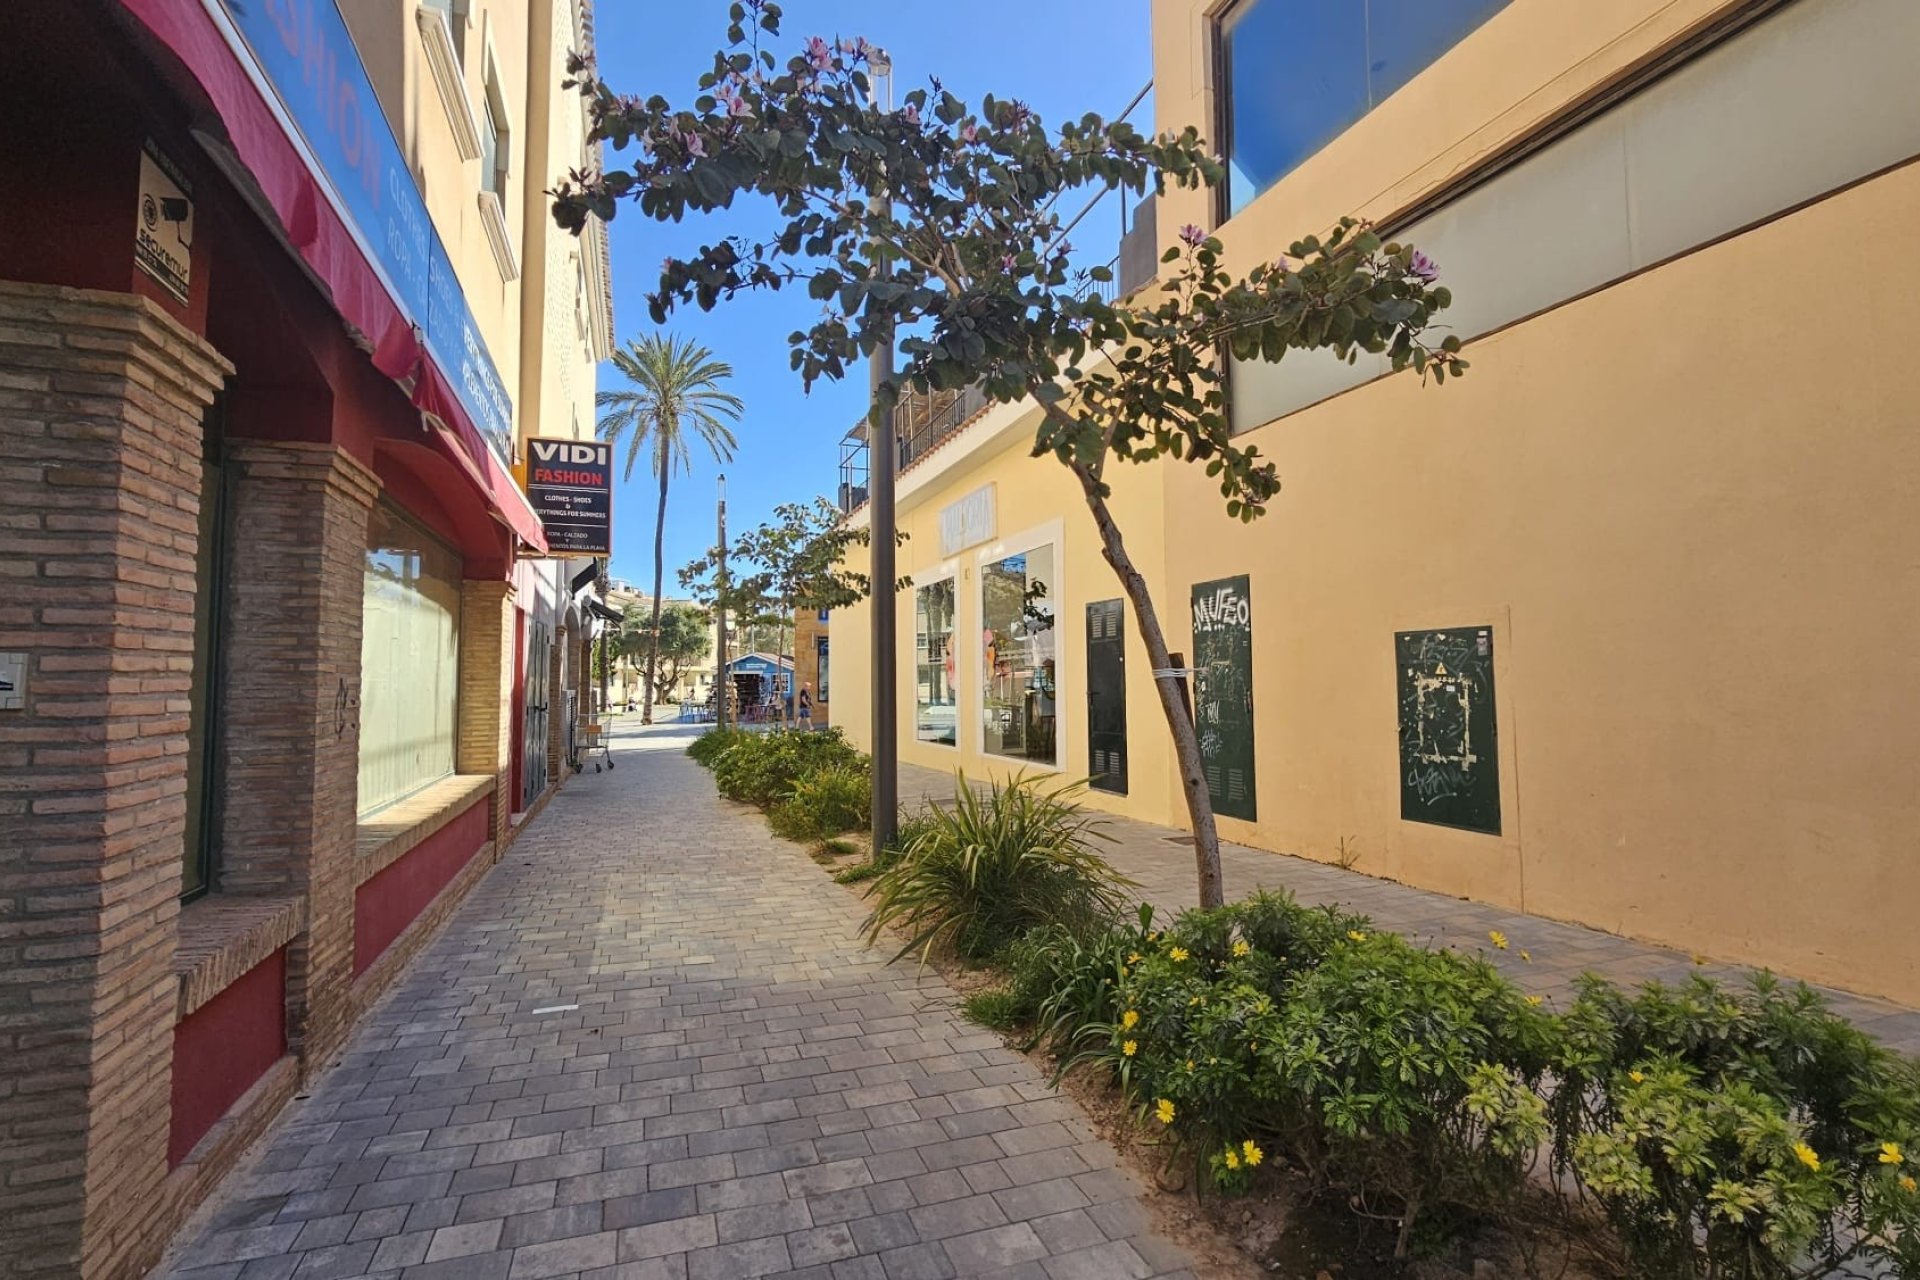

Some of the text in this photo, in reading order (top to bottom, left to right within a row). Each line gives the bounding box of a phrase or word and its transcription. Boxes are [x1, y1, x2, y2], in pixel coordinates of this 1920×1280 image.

[139, 228, 188, 278] securemur
[532, 441, 606, 465] VIDI
[535, 468, 603, 485] FASHION
[573, 496, 592, 504] SHOES
